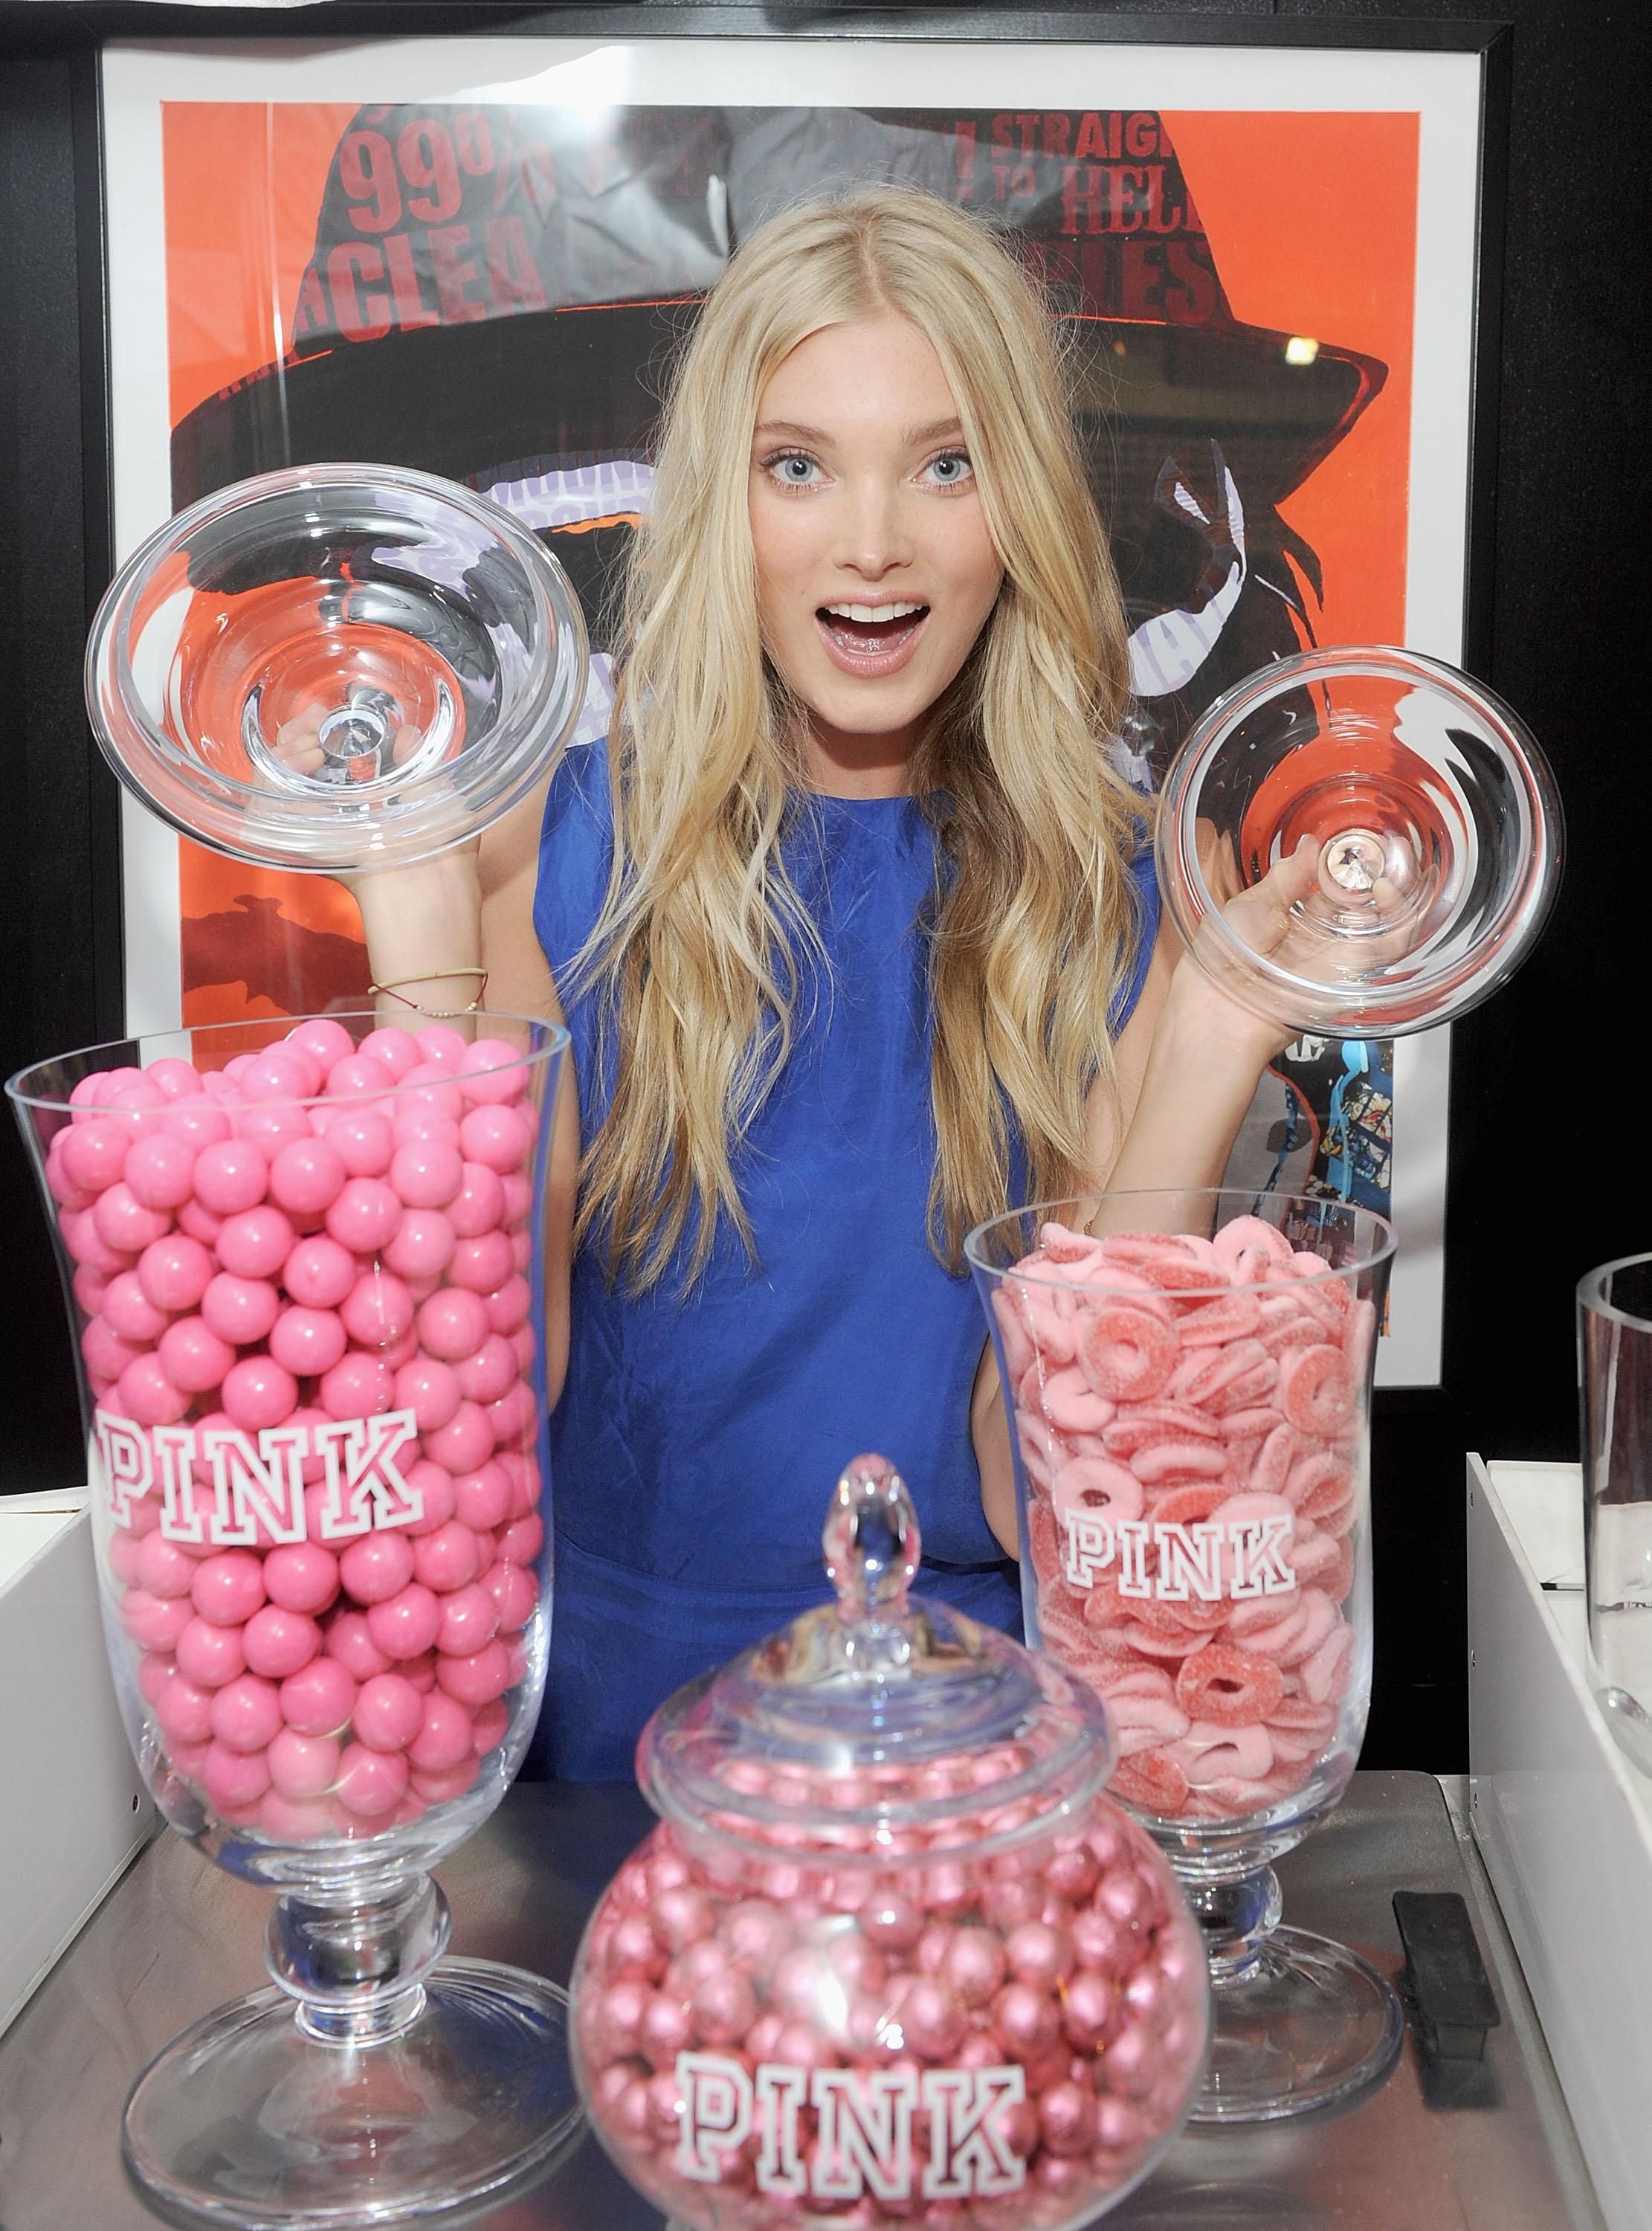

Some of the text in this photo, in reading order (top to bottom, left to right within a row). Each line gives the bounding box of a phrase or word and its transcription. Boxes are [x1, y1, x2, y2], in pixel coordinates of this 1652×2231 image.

[991, 162, 1036, 199] TO
[95, 1407, 425, 1545] PINK
[1064, 1507, 1297, 1602] PINK
[674, 2050, 1027, 2201] PINK
